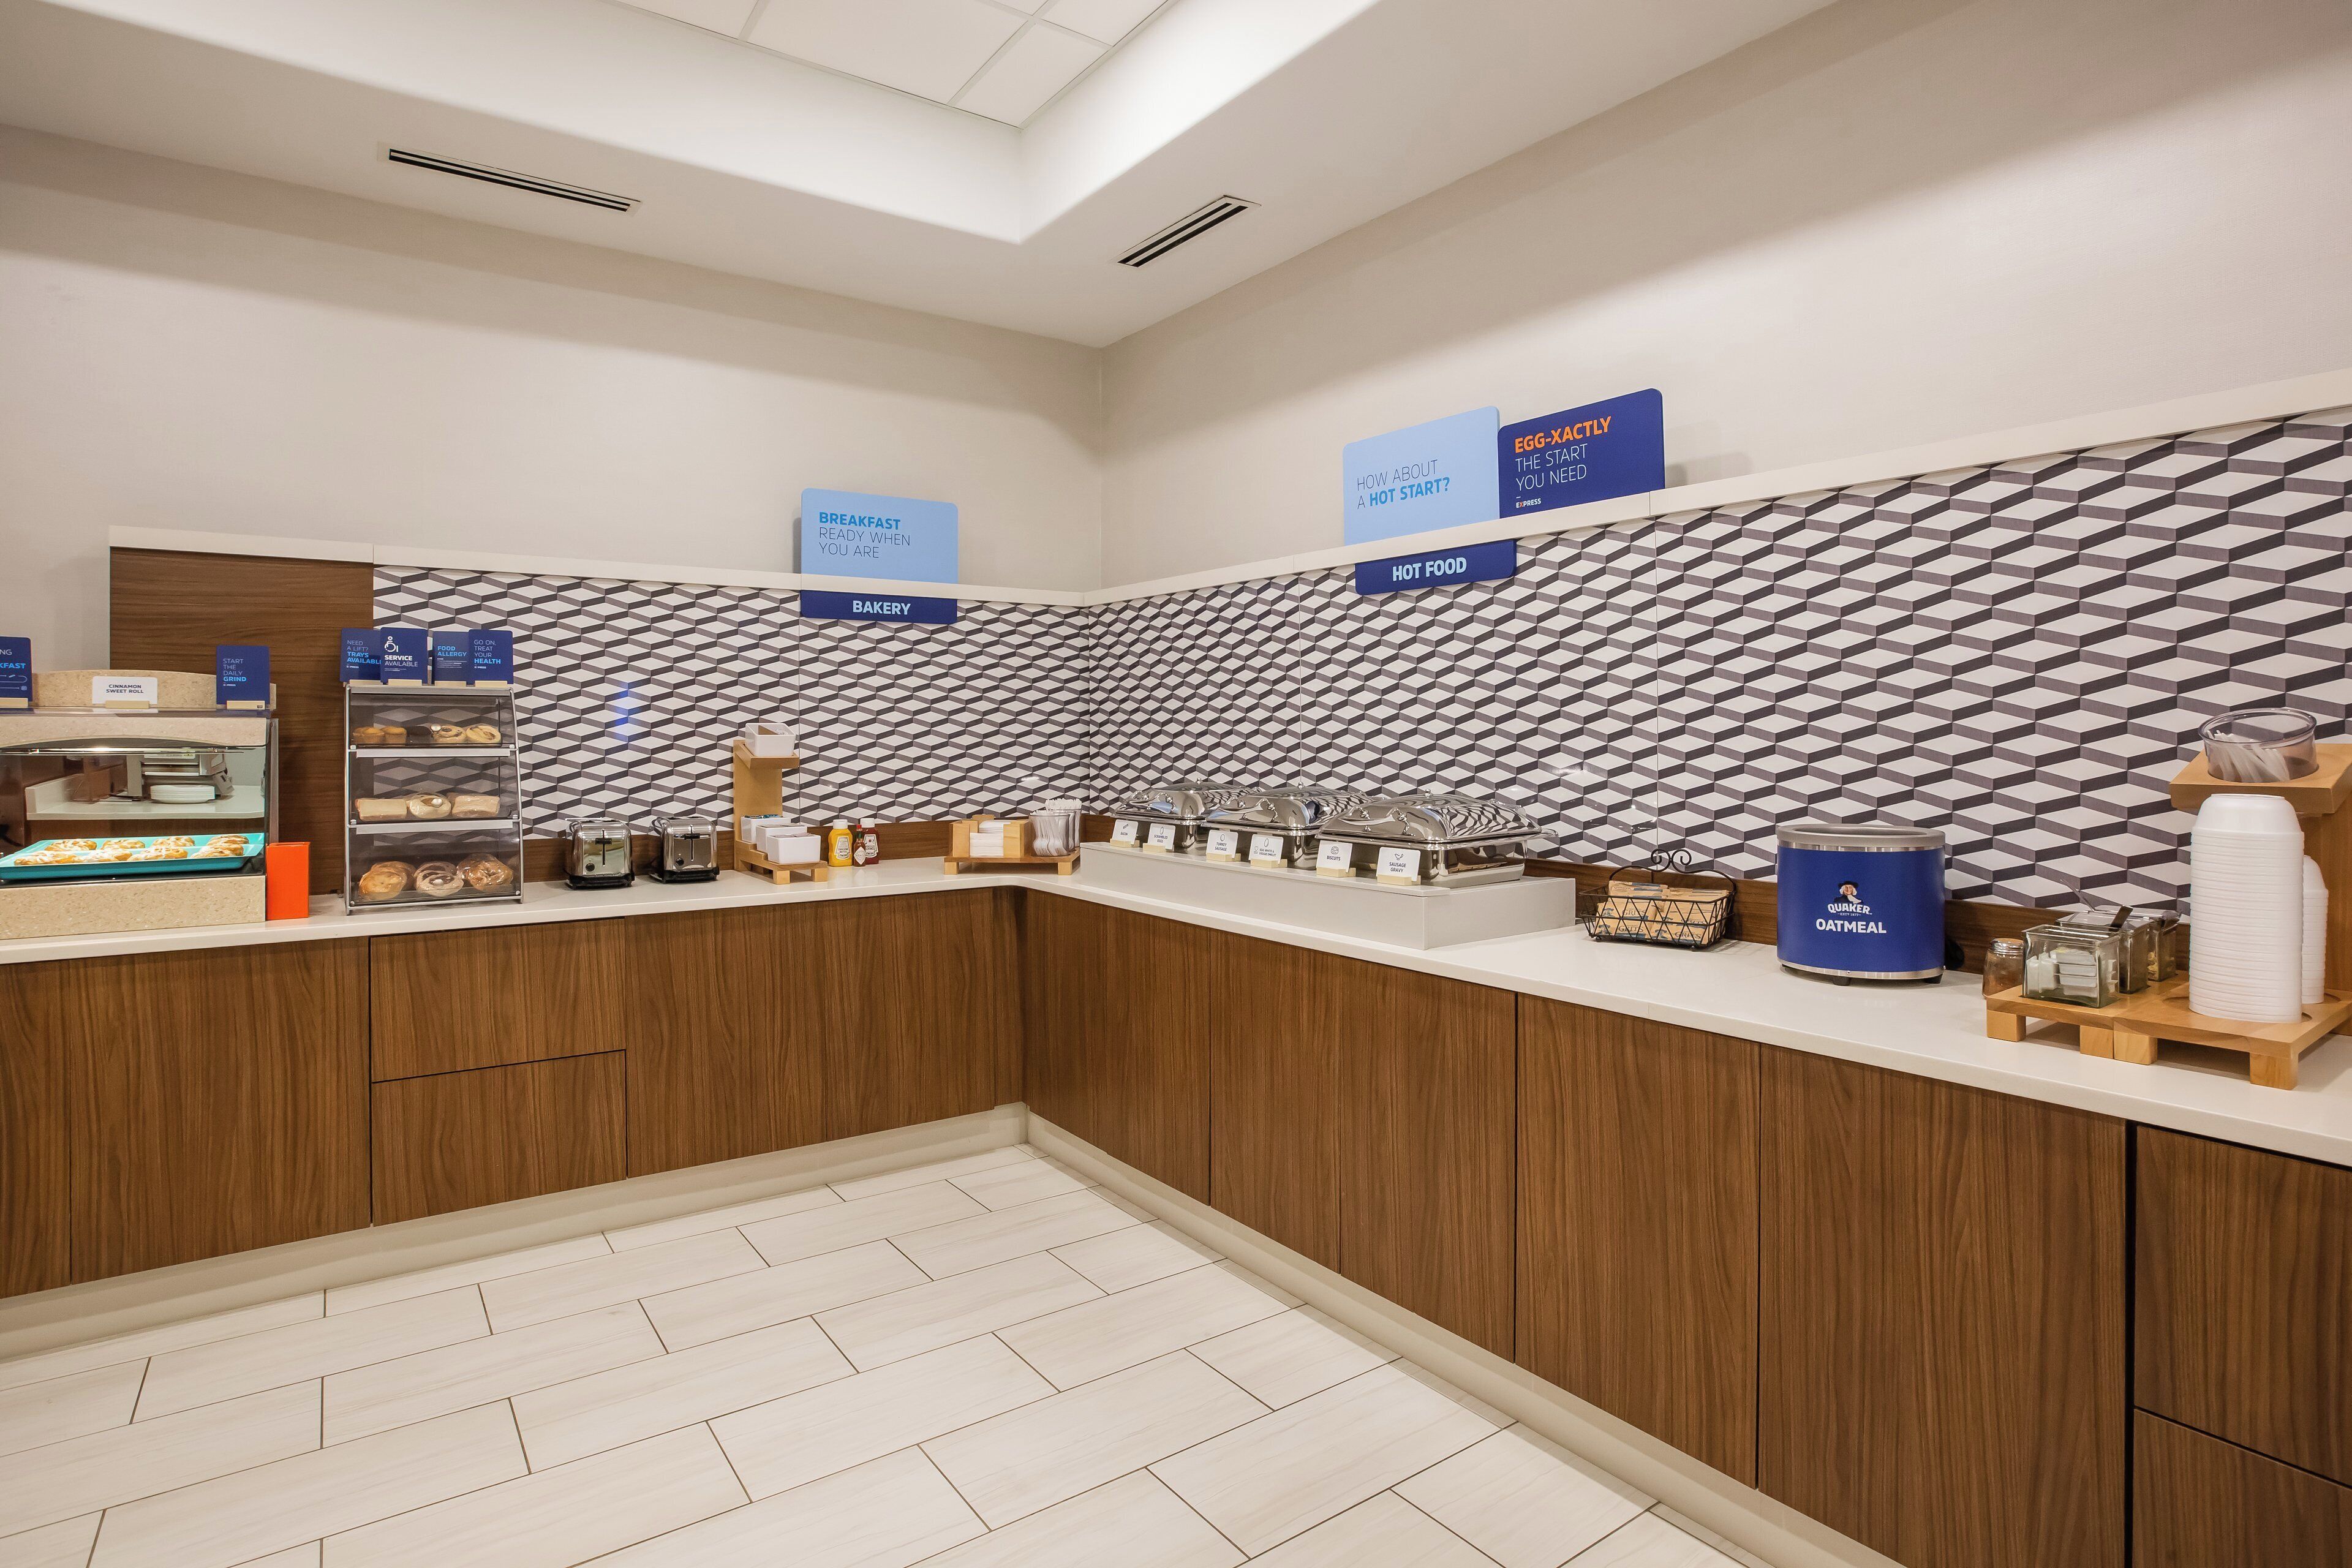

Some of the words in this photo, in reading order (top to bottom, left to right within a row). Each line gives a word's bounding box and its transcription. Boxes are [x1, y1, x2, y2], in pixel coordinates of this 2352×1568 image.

[1515, 416, 1611, 453] EGG-XACTLY
[1515, 454, 1540, 472] THE
[1546, 443, 1588, 467] START
[1357, 471, 1388, 491] HOW
[1392, 459, 1438, 483] ABOUT
[1516, 472, 1544, 491] YOU
[1550, 464, 1587, 485] NEED
[1357, 495, 1366, 510] A
[1370, 488, 1396, 507] HOT
[1400, 477, 1450, 500] START?
[1516, 498, 1542, 508] EXPRESS
[819, 511, 901, 530] BREAKFAST
[819, 527, 865, 542] READY
[870, 532, 910, 546] WHEN
[819, 542, 848, 556] YOU
[853, 545, 880, 559] ARE
[1392, 562, 1422, 582] HOT
[1425, 557, 1467, 578] FOOD
[853, 600, 911, 615] BAKERY
[1827, 903, 1870, 915] QUAKER
[1816, 918, 1887, 934] OATMEAL
